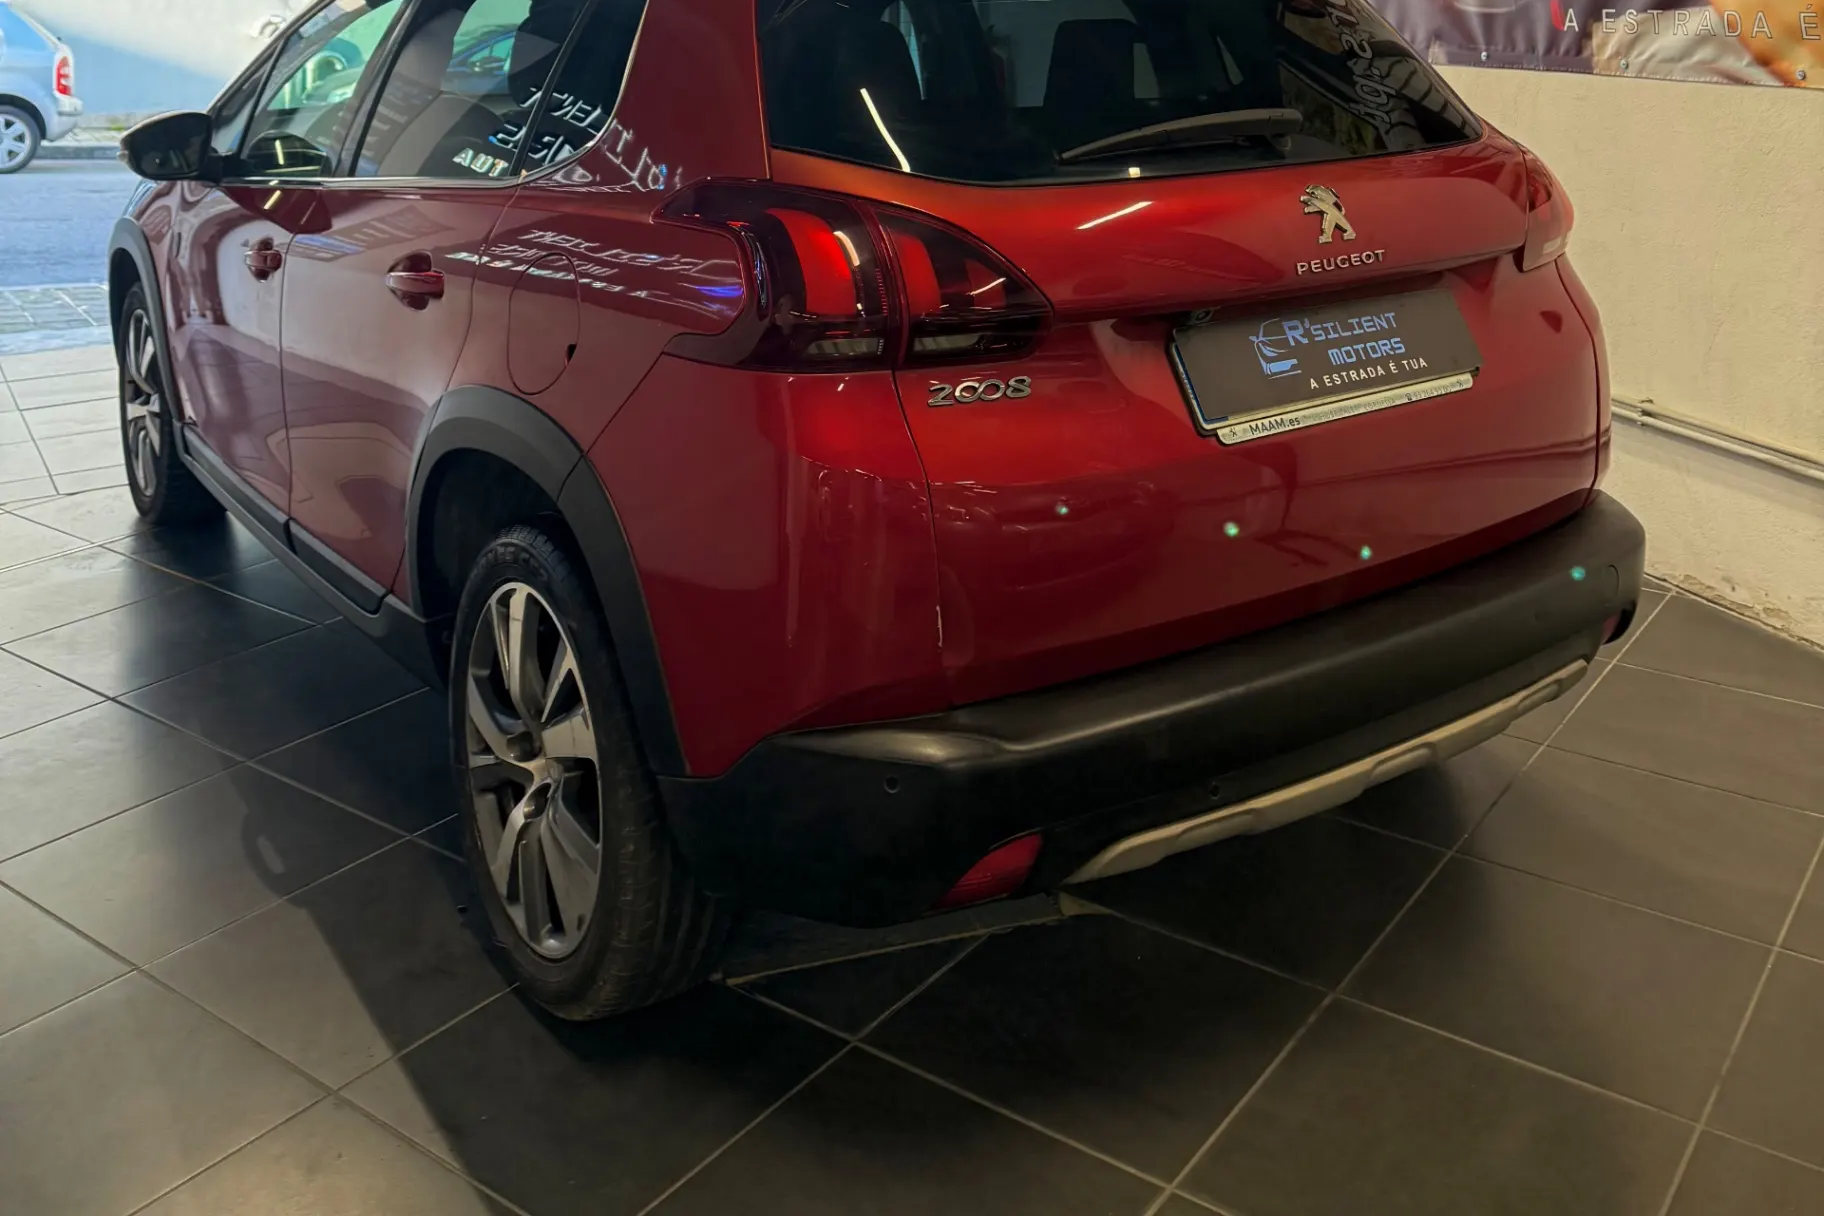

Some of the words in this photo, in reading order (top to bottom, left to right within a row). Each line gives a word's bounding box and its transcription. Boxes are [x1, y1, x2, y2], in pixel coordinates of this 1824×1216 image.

[1563, 8, 1579, 32] A
[1602, 8, 1773, 39] ESTRADA
[1800, 4, 1821, 40] É
[1297, 249, 1385, 275] PEUGEOT
[1282, 312, 1397, 346] R'SILIENT
[1328, 337, 1406, 366] MOTORS
[1310, 378, 1319, 390] A
[1323, 365, 1386, 387] ESTRADA
[1389, 360, 1398, 374] É
[1401, 357, 1428, 372] TUA
[928, 376, 1031, 406] 2008
[1249, 415, 1301, 436] MAAM.es
